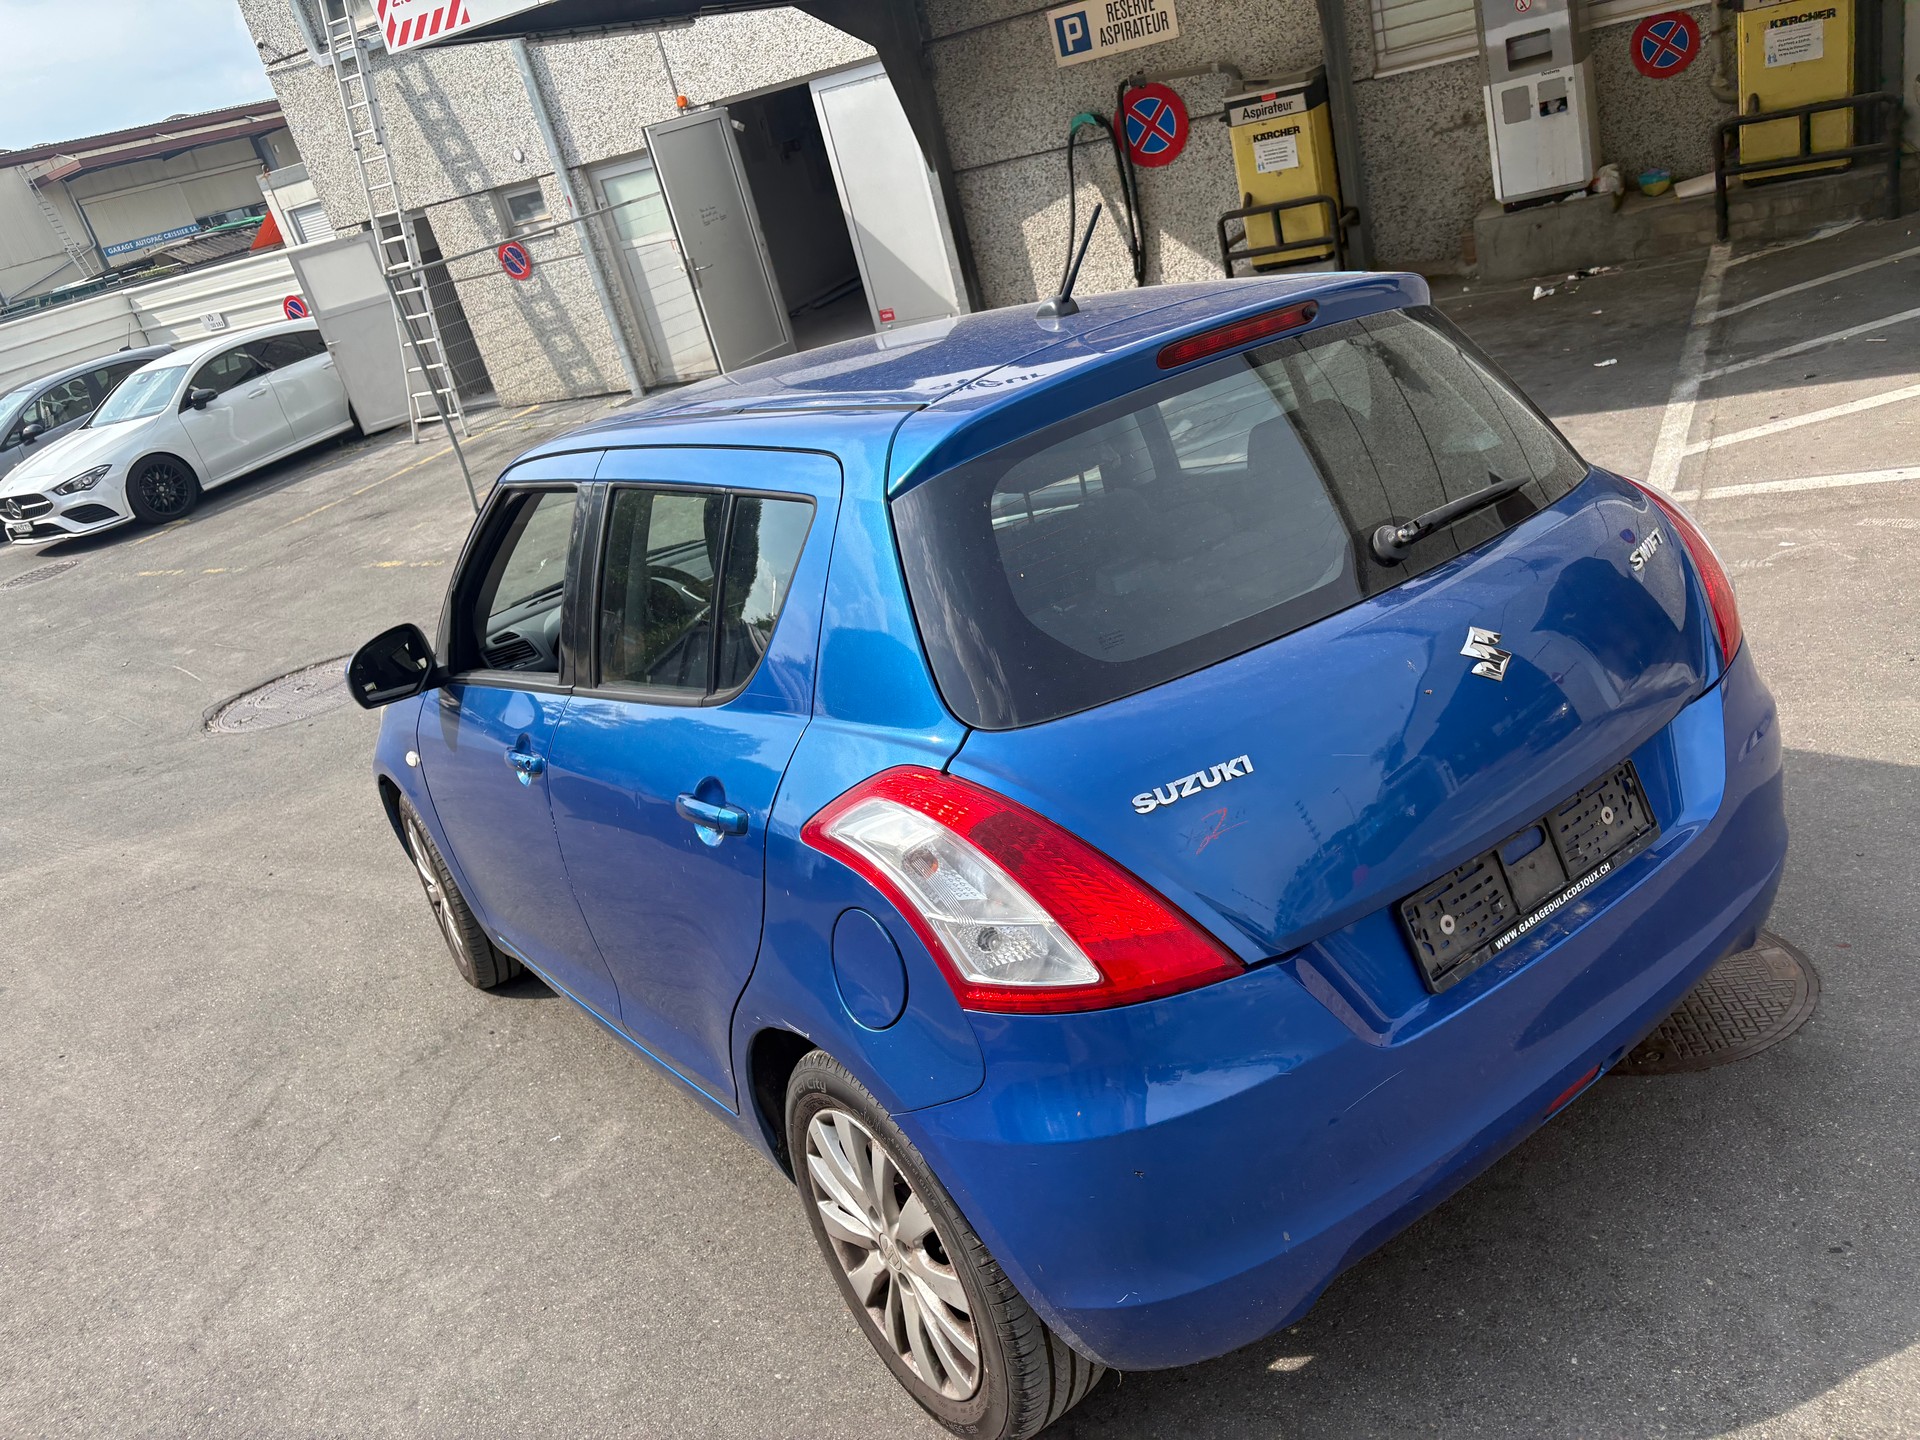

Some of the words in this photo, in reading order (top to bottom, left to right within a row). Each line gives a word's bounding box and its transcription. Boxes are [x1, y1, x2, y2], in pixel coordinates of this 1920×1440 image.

[1062, 16, 1083, 52] P
[1099, 10, 1170, 47] ASPIRATEUR
[1242, 100, 1294, 120] Aspirateur
[107, 242, 134, 255] GARAGE
[135, 234, 163, 248] AUTOPAC
[163, 227, 189, 240] CRISSIER
[189, 225, 198, 233] SA
[1629, 526, 1663, 572] SWIFT
[1131, 754, 1255, 815] SUZUKI
[1494, 862, 1612, 950] WWW.GARAGEDULACDEJOUX.CH
